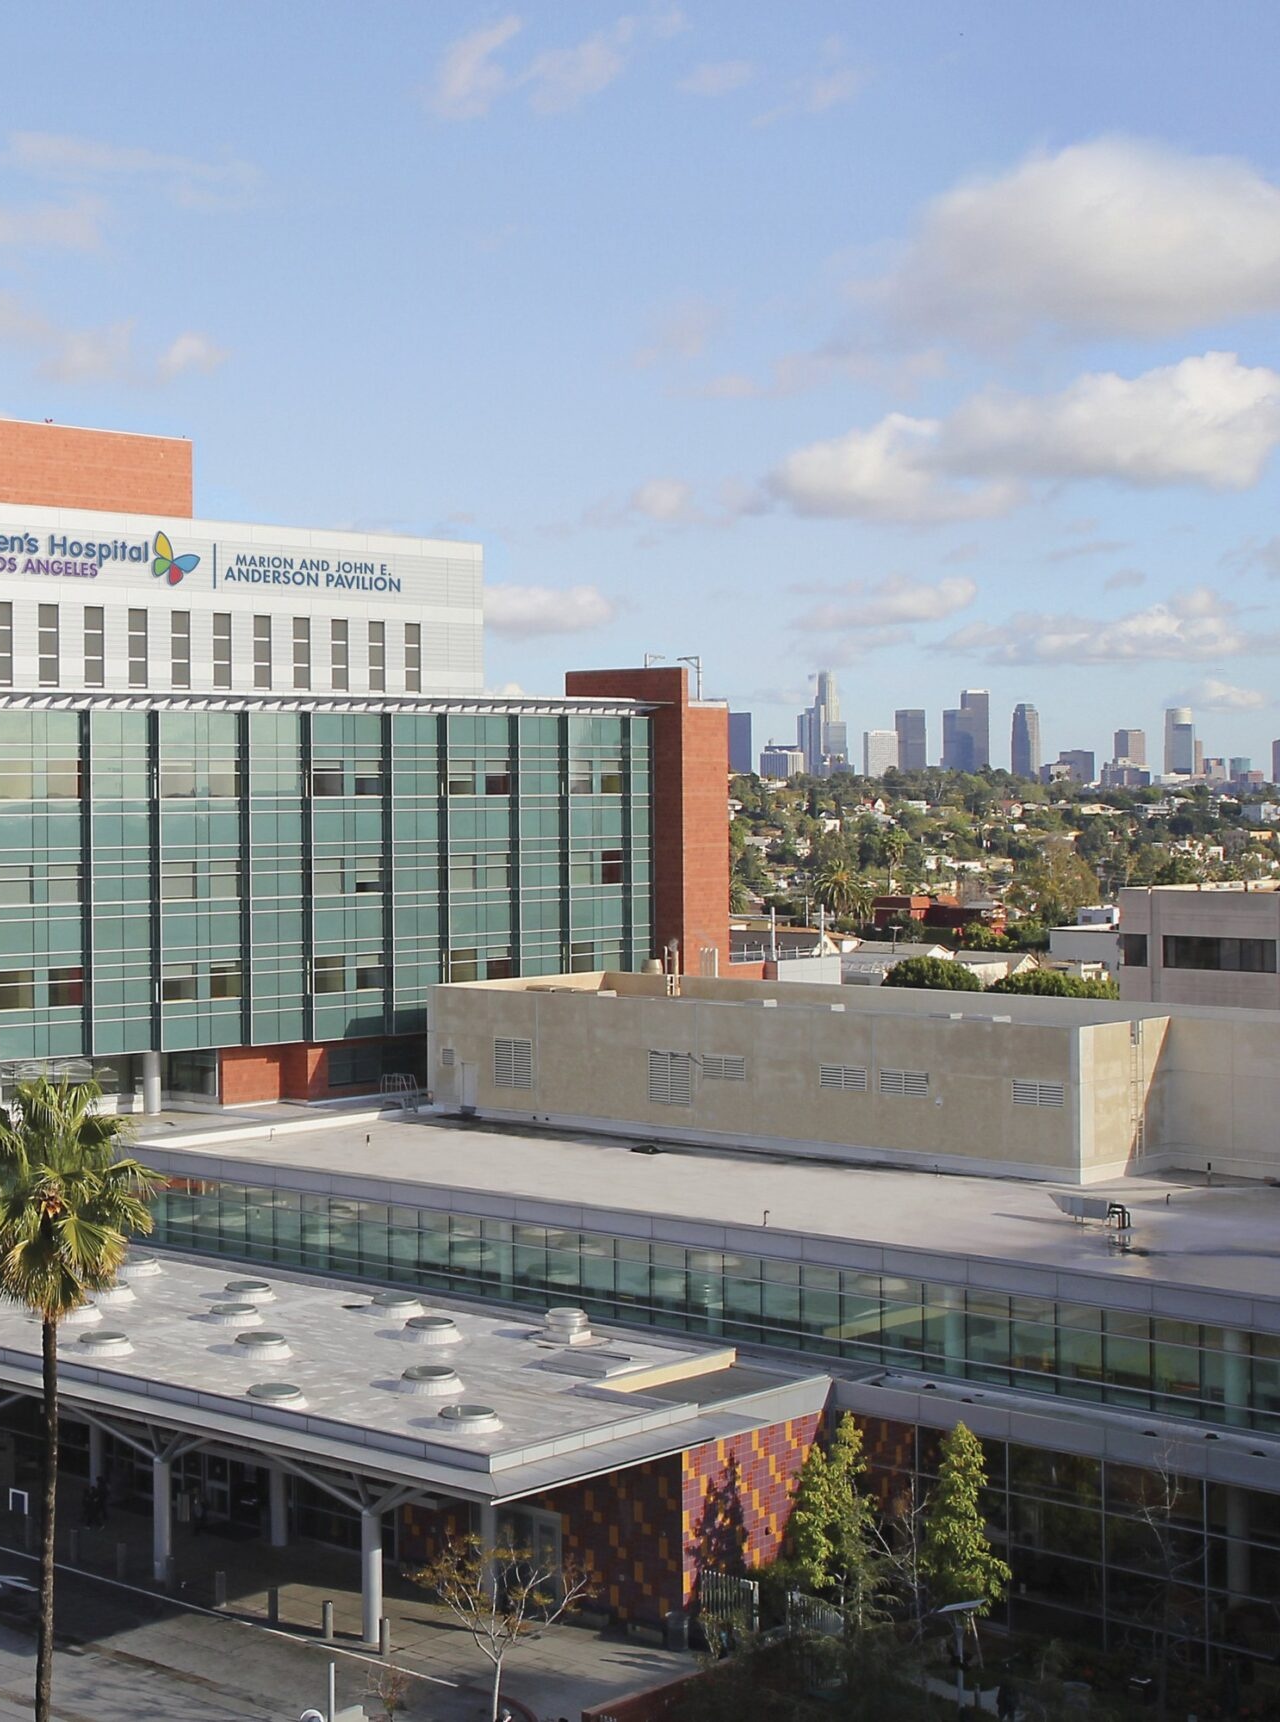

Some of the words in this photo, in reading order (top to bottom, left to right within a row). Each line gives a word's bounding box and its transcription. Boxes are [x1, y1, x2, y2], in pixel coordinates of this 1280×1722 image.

[49, 534, 149, 568] Hospital
[22, 558, 98, 578] ANGELES
[235, 553, 294, 570] MARION
[299, 558, 330, 572] AND
[335, 561, 375, 576] JOHN
[380, 563, 392, 576] E.
[224, 566, 320, 587] ANDERSON
[325, 573, 402, 593] PAVILION
